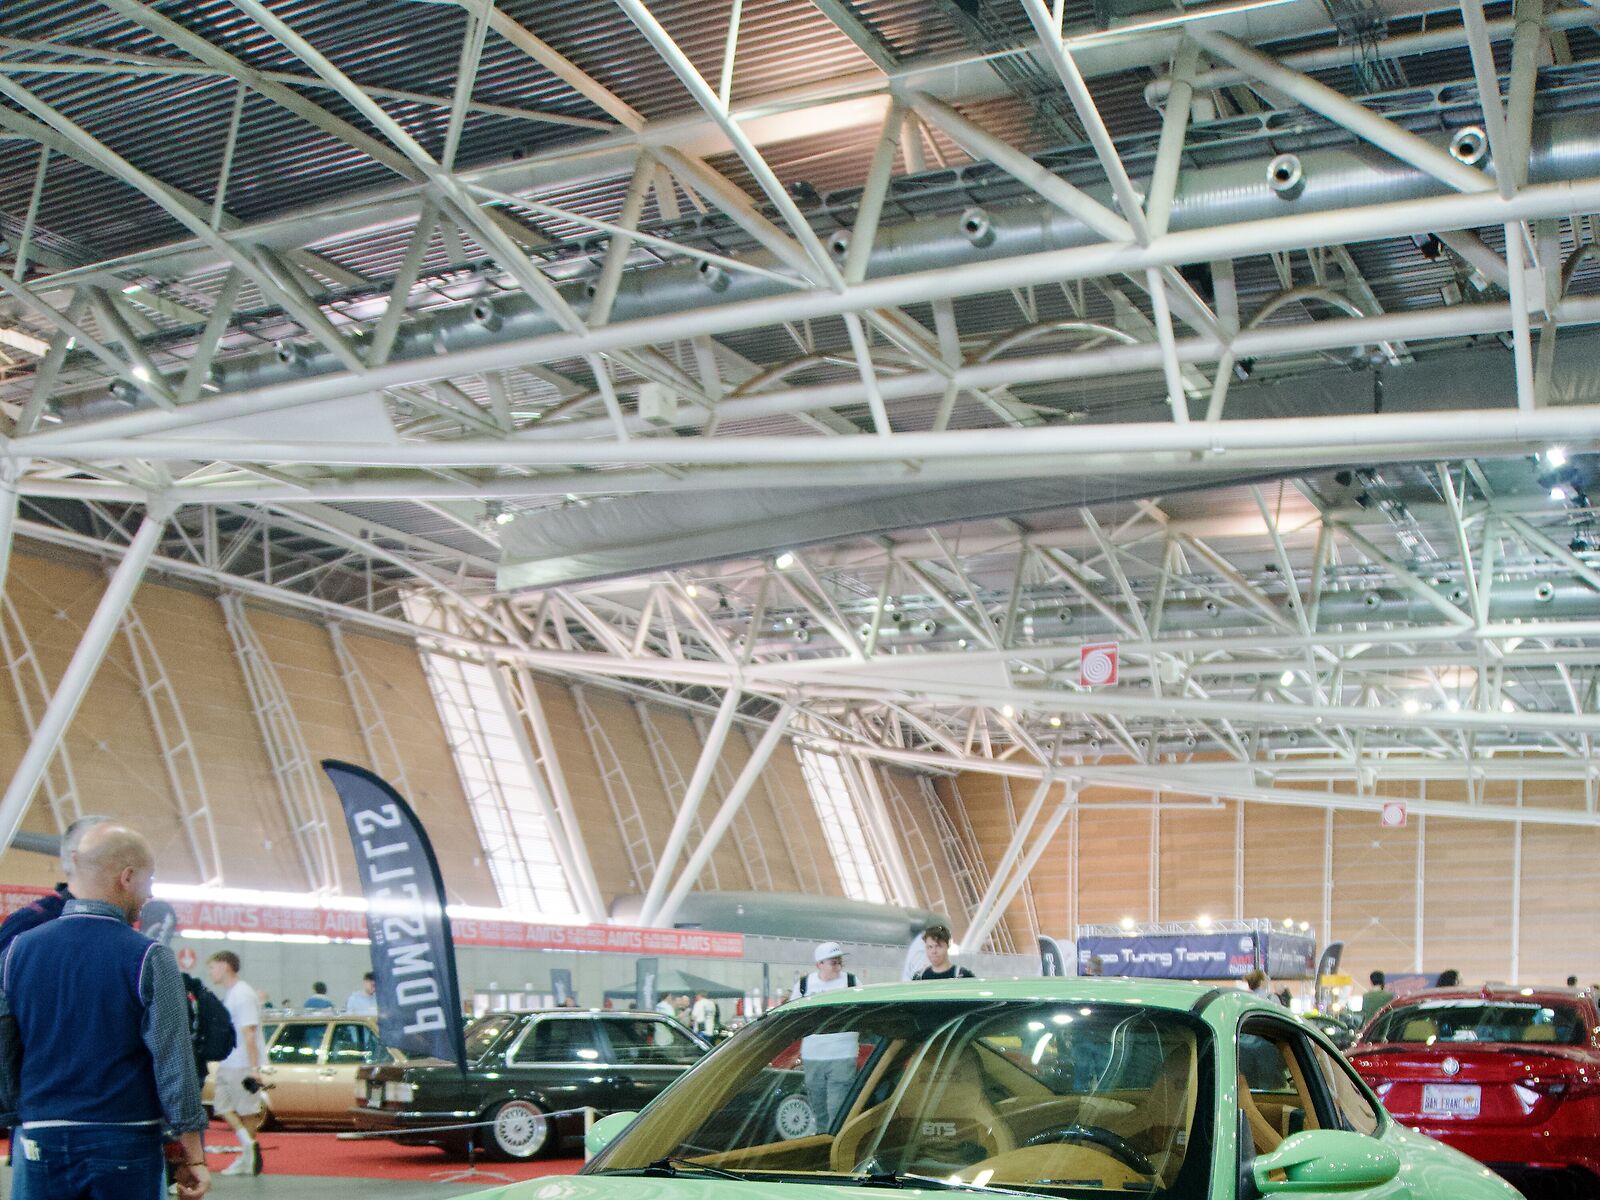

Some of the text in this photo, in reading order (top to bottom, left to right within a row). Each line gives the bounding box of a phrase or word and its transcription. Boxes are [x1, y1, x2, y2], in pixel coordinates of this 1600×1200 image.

[526, 925, 565, 944] AMTS
[608, 932, 642, 948] AMTS
[679, 936, 711, 951] AMTS
[1121, 948, 1173, 966] Tuning
[1175, 947, 1226, 961] Torino
